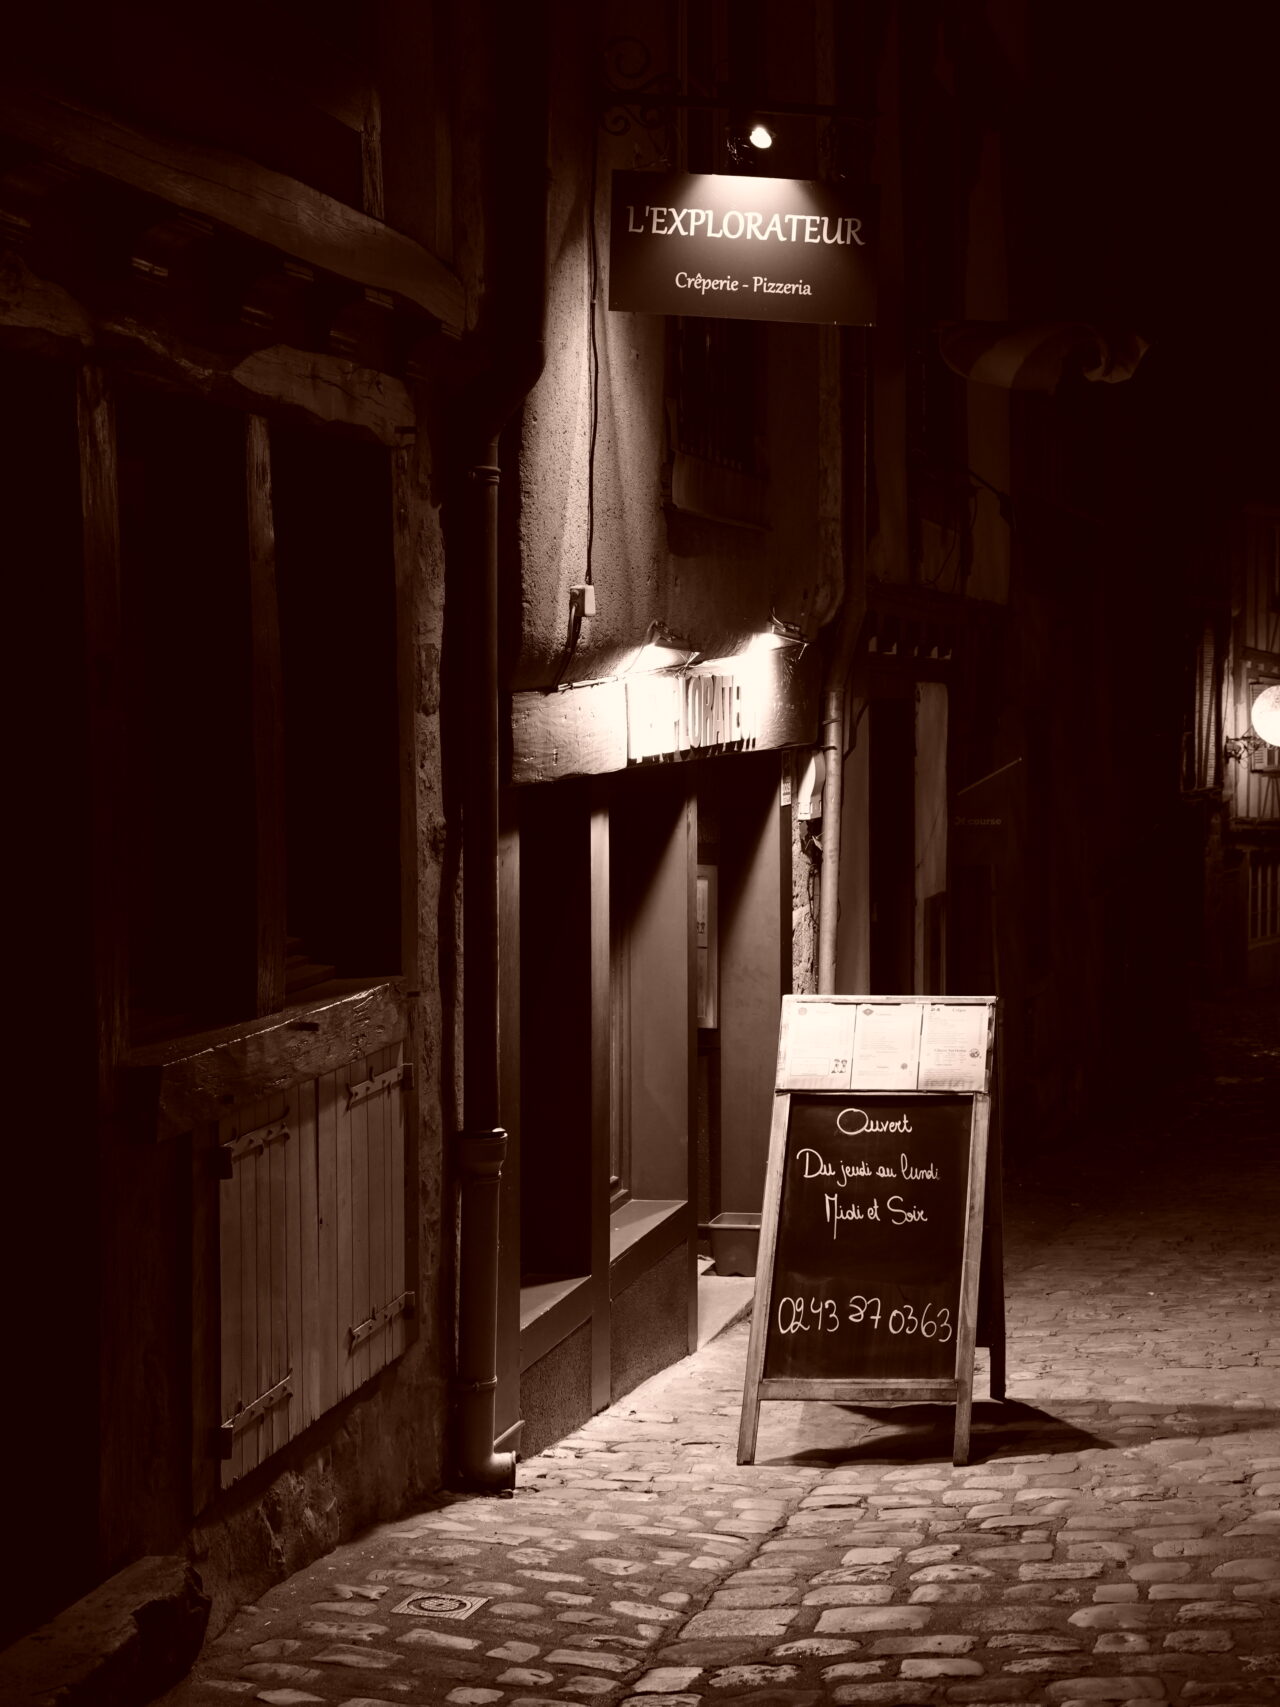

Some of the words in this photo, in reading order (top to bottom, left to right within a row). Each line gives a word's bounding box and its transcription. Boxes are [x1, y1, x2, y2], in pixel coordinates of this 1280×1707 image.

[627, 206, 865, 246] L'EXPLORATEUR
[675, 271, 739, 295] Crêperie
[752, 276, 812, 295] Pizzeria
[836, 1108, 913, 1135] Ouvert
[796, 1148, 836, 1179] Du
[837, 1160, 872, 1188] jeudi
[876, 1165, 897, 1178] au
[900, 1153, 940, 1180] lundi
[825, 1193, 865, 1240] Midi
[867, 1198, 881, 1221] et
[887, 1195, 929, 1225] Soir
